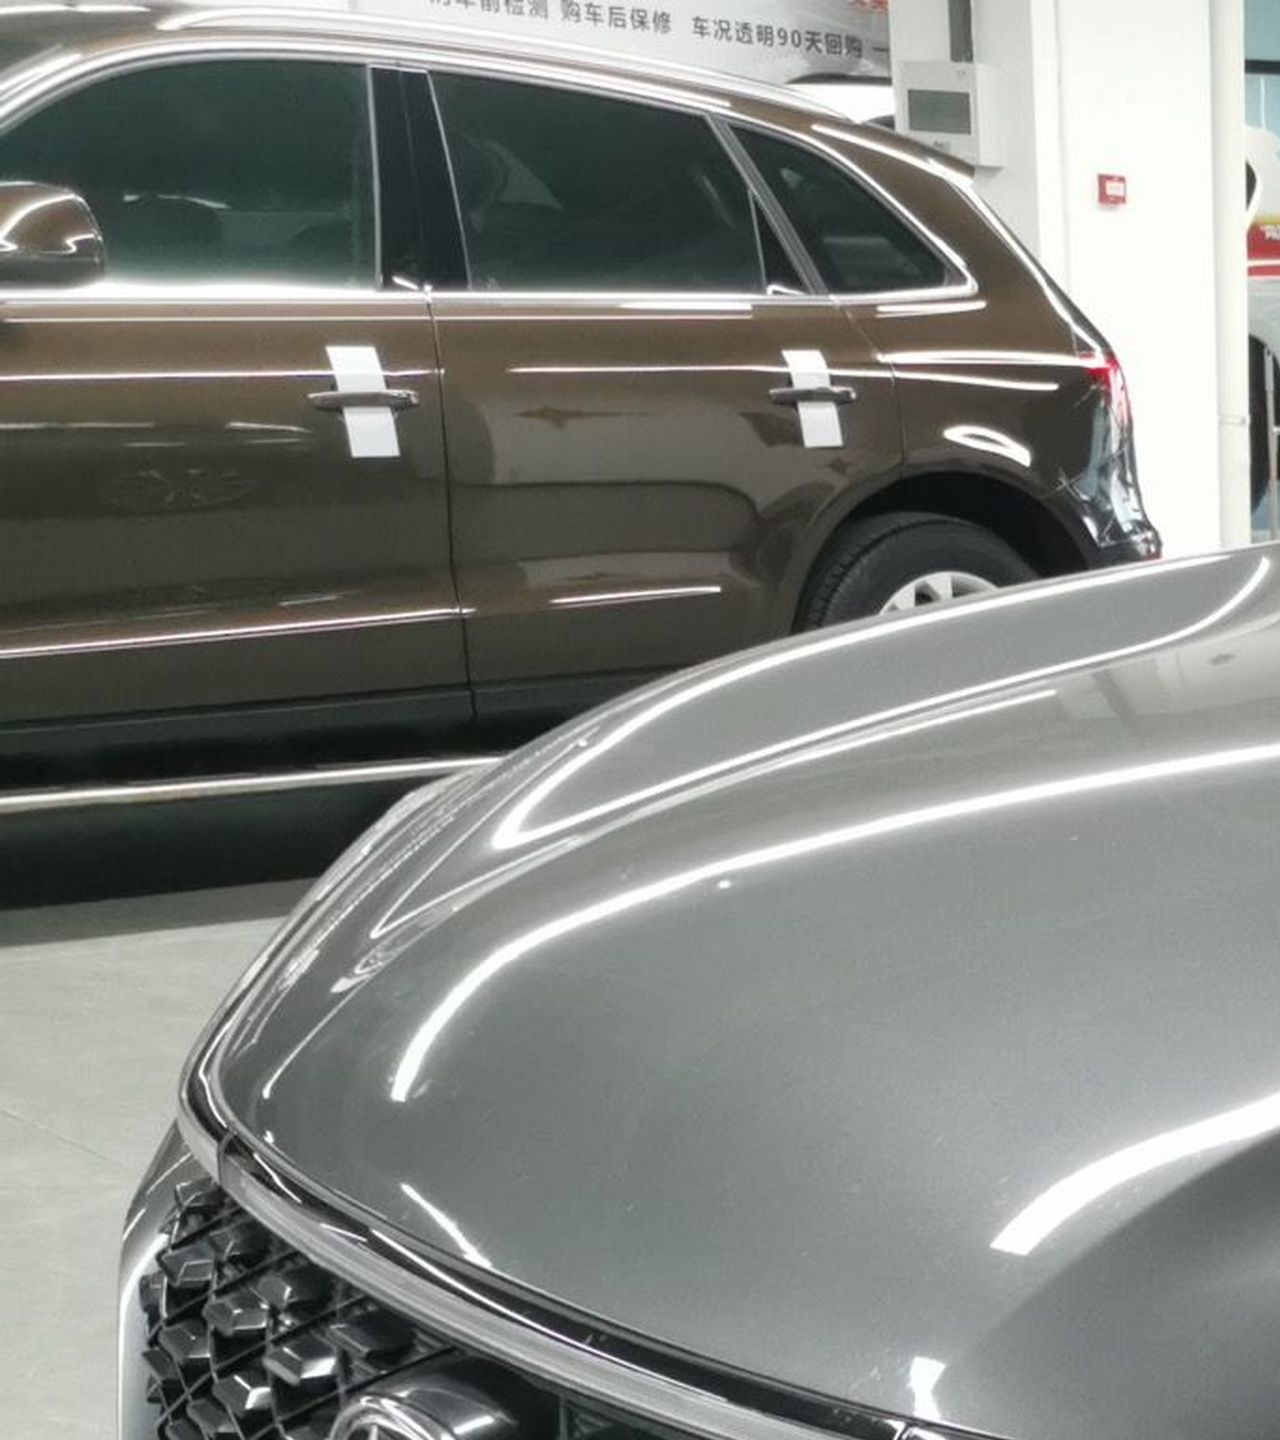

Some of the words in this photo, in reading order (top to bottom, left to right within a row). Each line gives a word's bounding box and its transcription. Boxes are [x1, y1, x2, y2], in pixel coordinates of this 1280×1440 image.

[562, 0, 673, 33] 购车后保修
[692, 16, 864, 58] 车况透明90天回购
